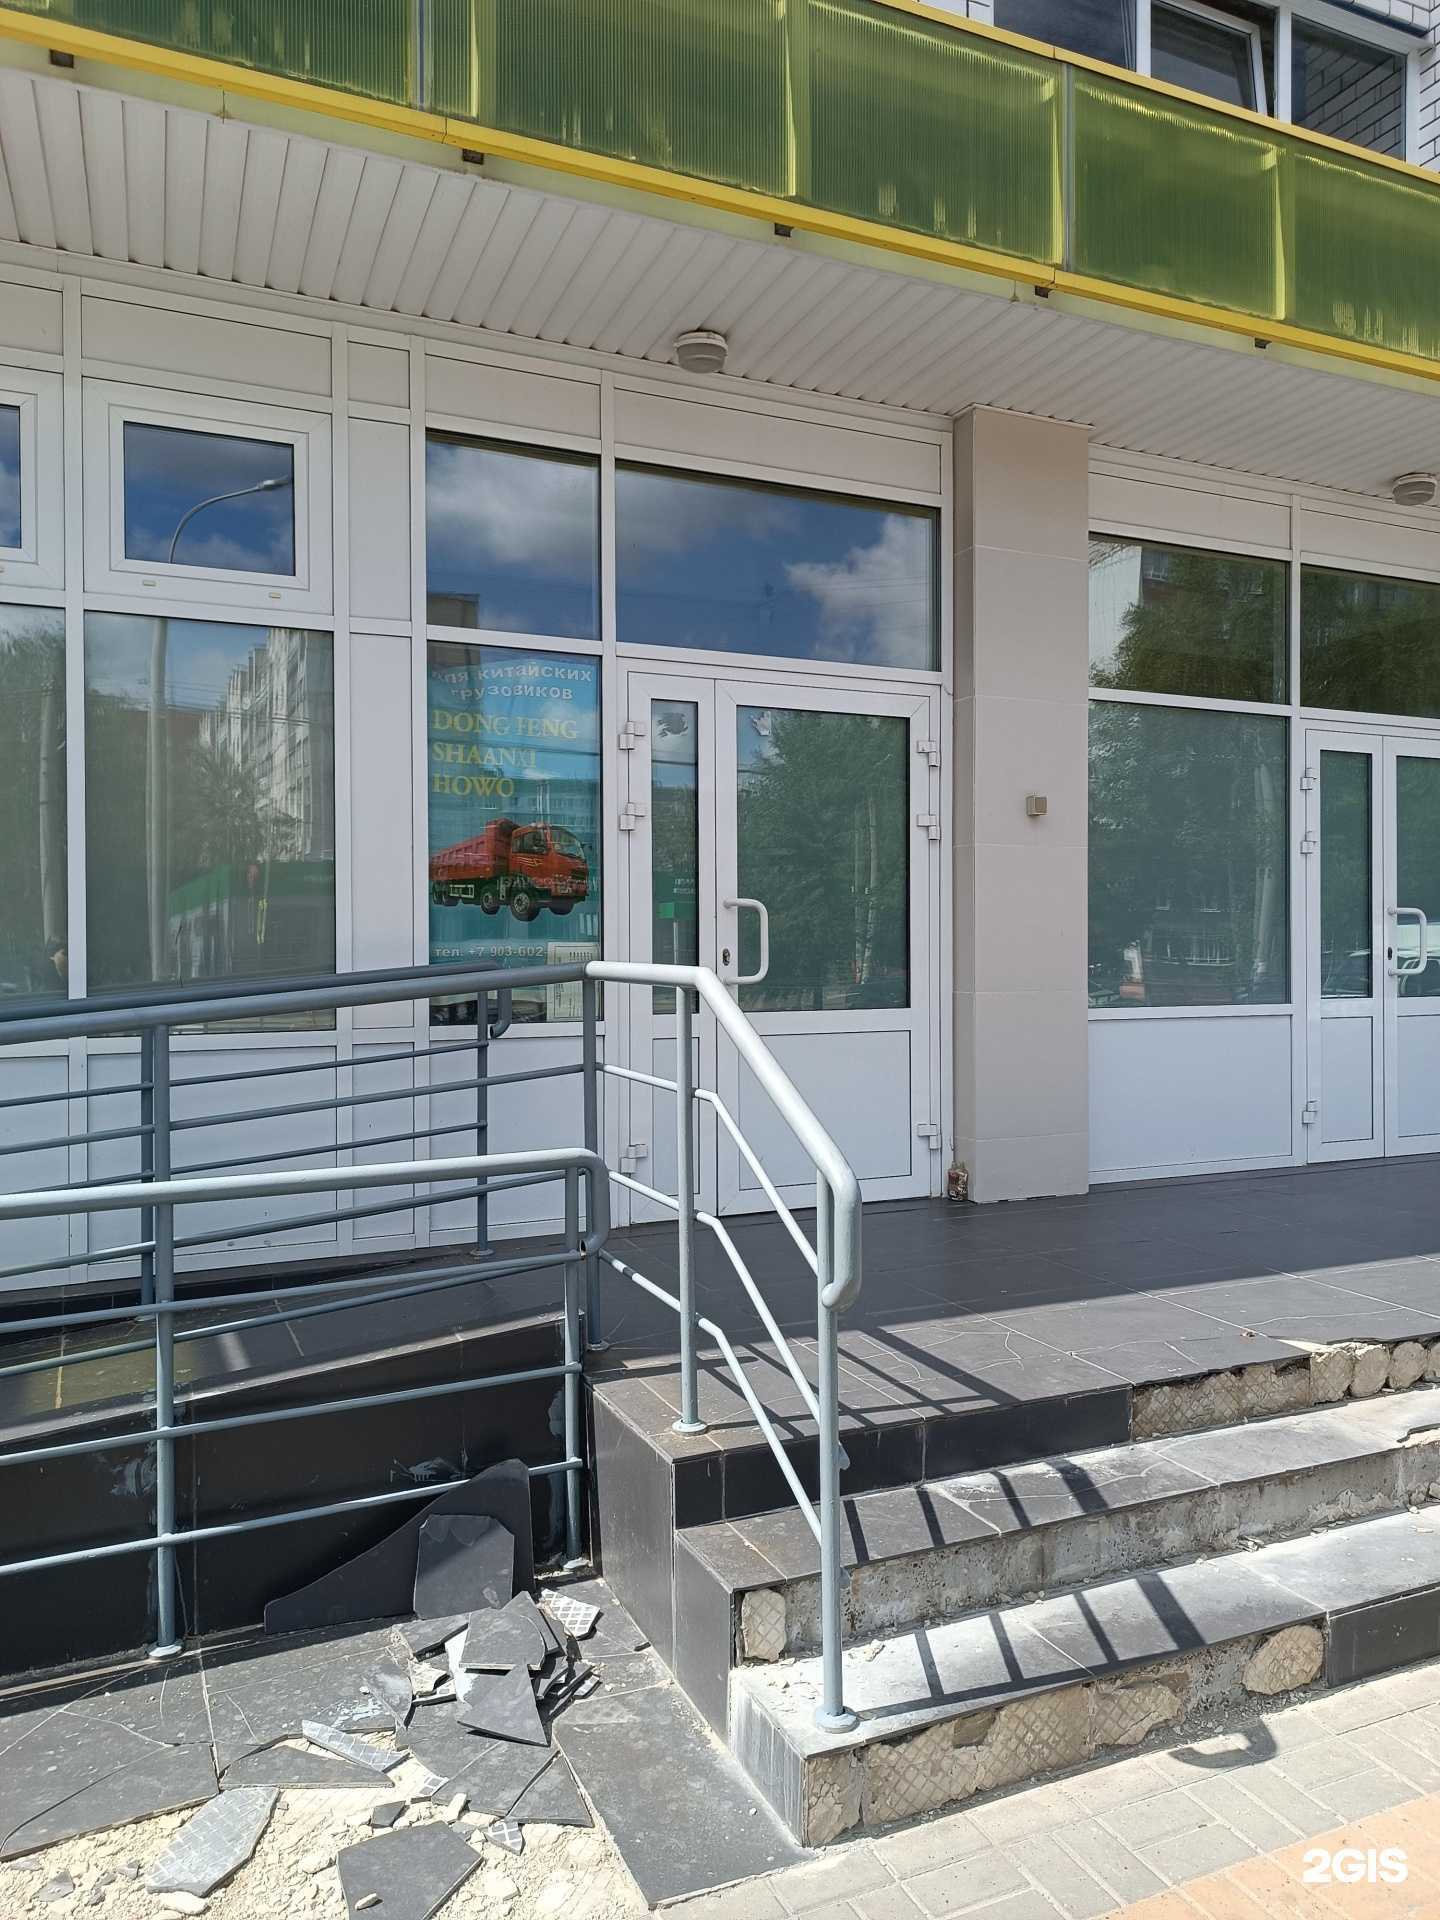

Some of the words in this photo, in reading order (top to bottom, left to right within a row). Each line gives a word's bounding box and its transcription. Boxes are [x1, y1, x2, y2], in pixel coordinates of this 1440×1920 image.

[479, 662, 593, 682] китайских
[433, 709, 510, 736] DONG
[517, 716, 578, 739] FENG
[432, 741, 537, 768] SHAANXI
[432, 773, 514, 798] HOWO
[434, 947, 464, 957] тел.
[468, 946, 485, 957] +7
